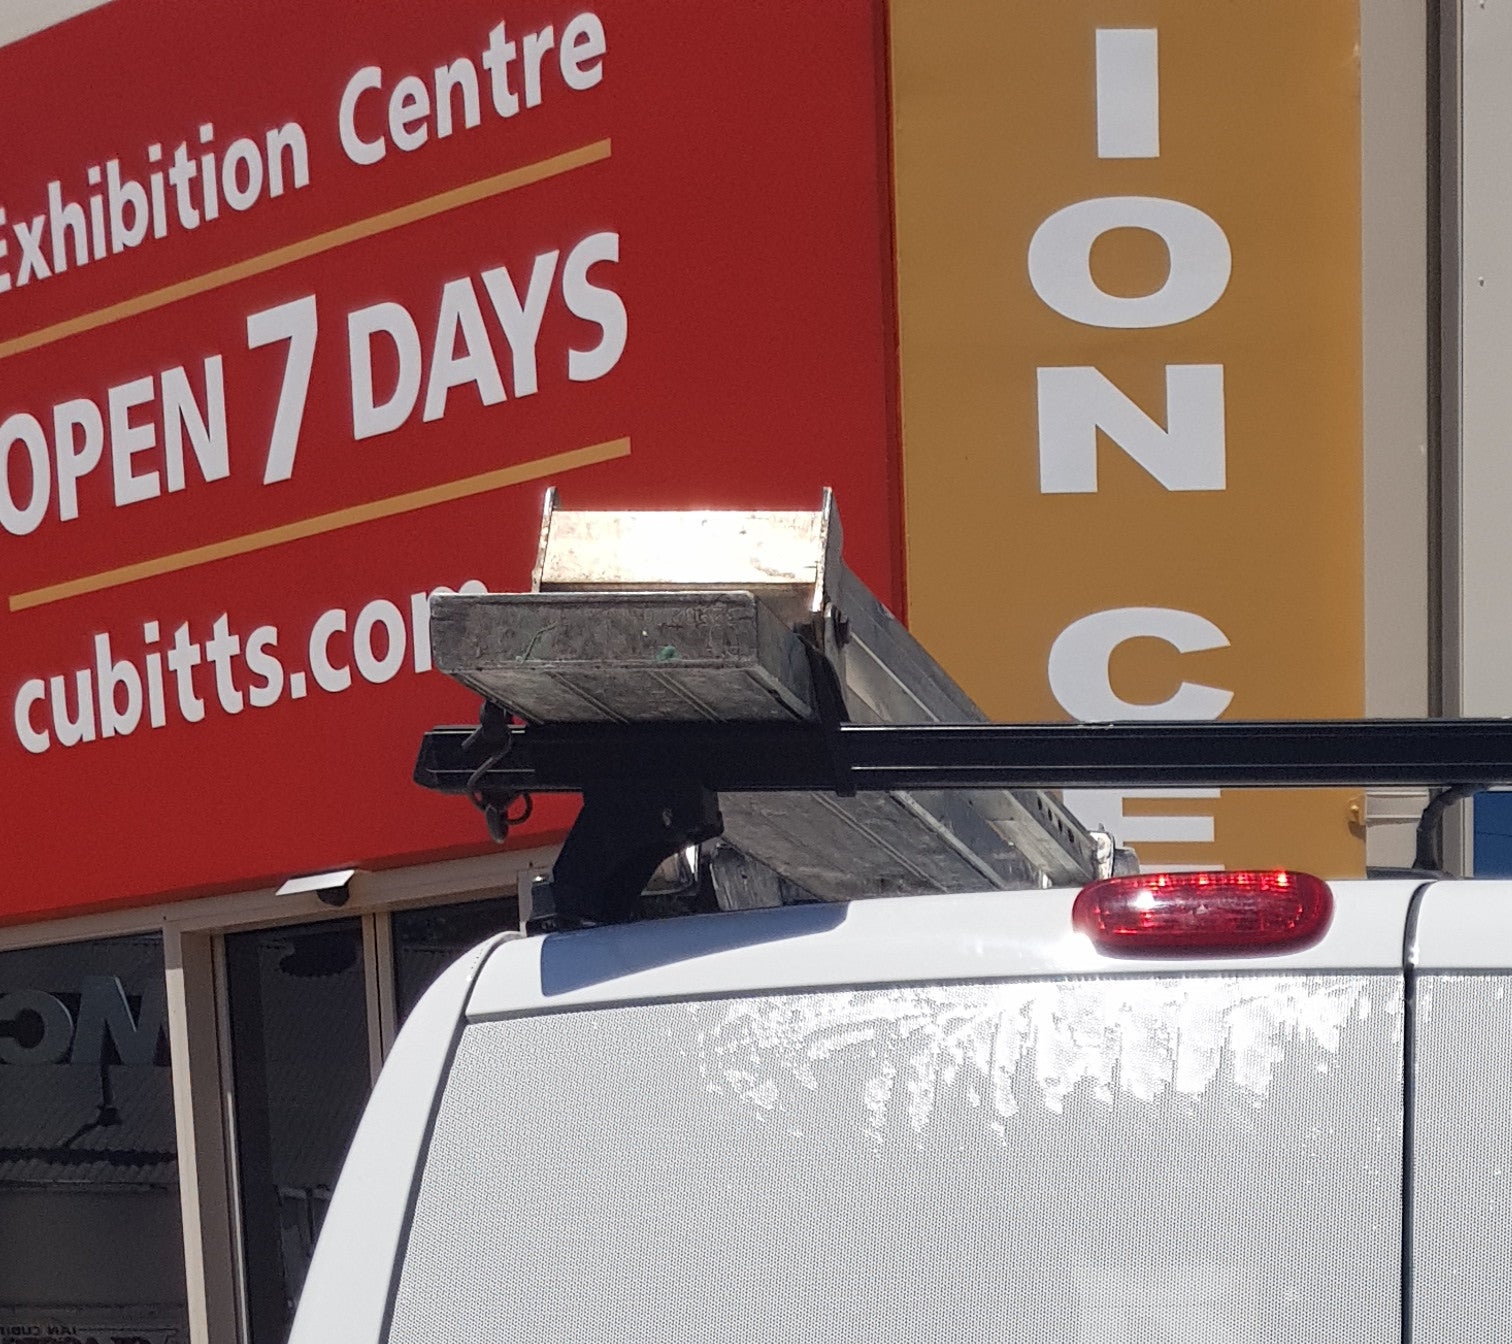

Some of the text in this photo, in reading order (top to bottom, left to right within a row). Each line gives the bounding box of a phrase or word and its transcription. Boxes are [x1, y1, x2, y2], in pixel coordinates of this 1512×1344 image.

[338, 11, 607, 166] Centre
[0, 232, 628, 536] OPEN 7 DAYS
